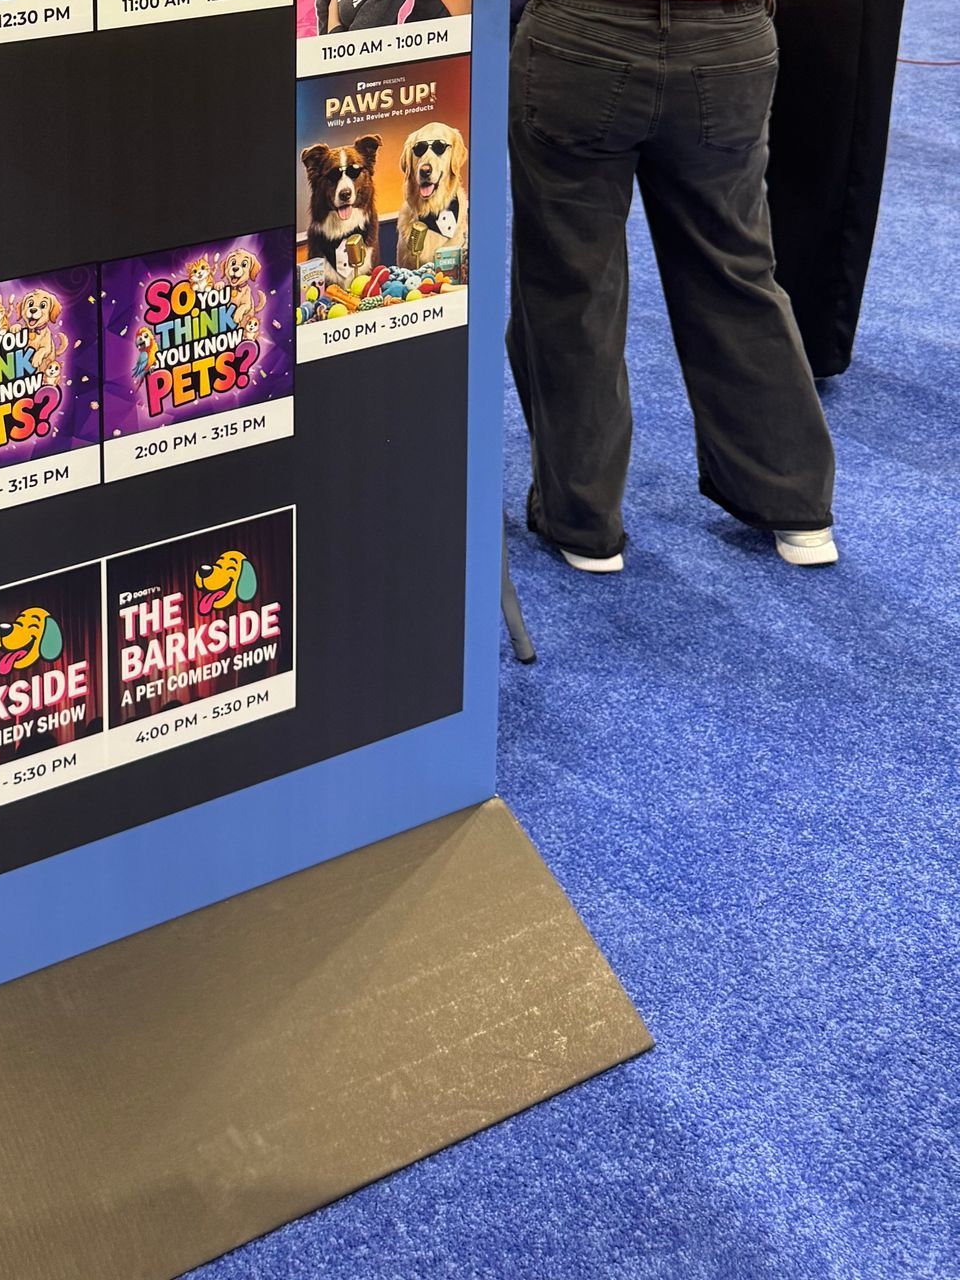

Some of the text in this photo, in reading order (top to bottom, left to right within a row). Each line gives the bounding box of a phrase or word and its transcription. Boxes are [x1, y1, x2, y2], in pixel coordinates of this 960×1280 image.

[44, 5, 70, 23] PM
[321, 29, 448, 60] 11:00 AM 1:00 PM
[325, 82, 437, 119] PAWS UP!
[144, 278, 230, 325] SO YOU
[322, 306, 443, 345] 1:00 PM 3:00 PM
[156, 328, 244, 369] YOU KNOW
[146, 339, 260, 418] PETS?
[135, 415, 266, 460] 2:00 PM 3:15 PM
[8, 473, 39, 493] 3:15
[43, 465, 69, 485] PM
[119, 592, 184, 641] THE
[120, 601, 281, 683] BARKSIDE
[120, 642, 278, 708] A PET COMEDY SHOW
[36, 703, 87, 734] SHOW
[135, 690, 269, 743] 4:00 PM 5:30 PM
[12, 764, 47, 785] 5:30
[52, 753, 77, 773] PM
